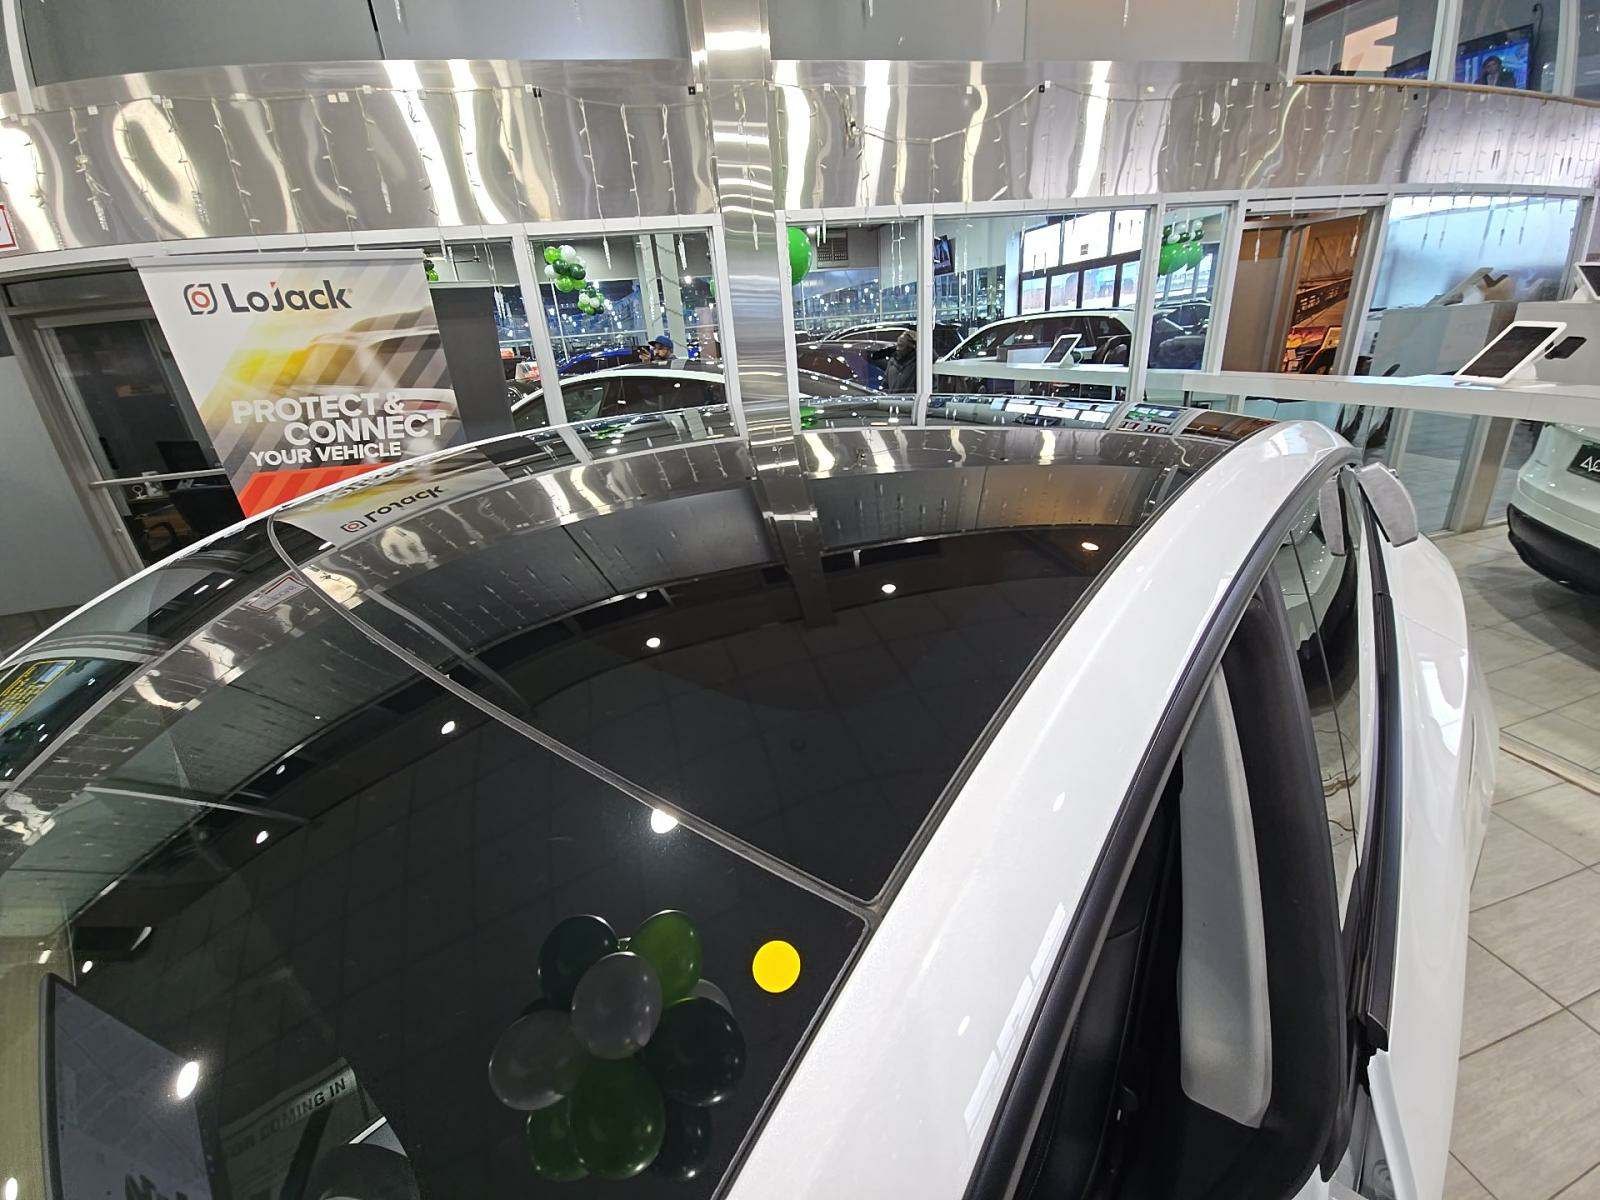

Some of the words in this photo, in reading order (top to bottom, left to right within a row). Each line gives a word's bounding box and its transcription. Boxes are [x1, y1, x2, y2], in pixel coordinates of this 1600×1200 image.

[231, 392, 381, 424] PROTECT
[284, 409, 448, 446] CONNECT
[250, 448, 313, 467] YOUR
[315, 441, 402, 462] VEHICLE
[328, 1077, 346, 1098] IN
